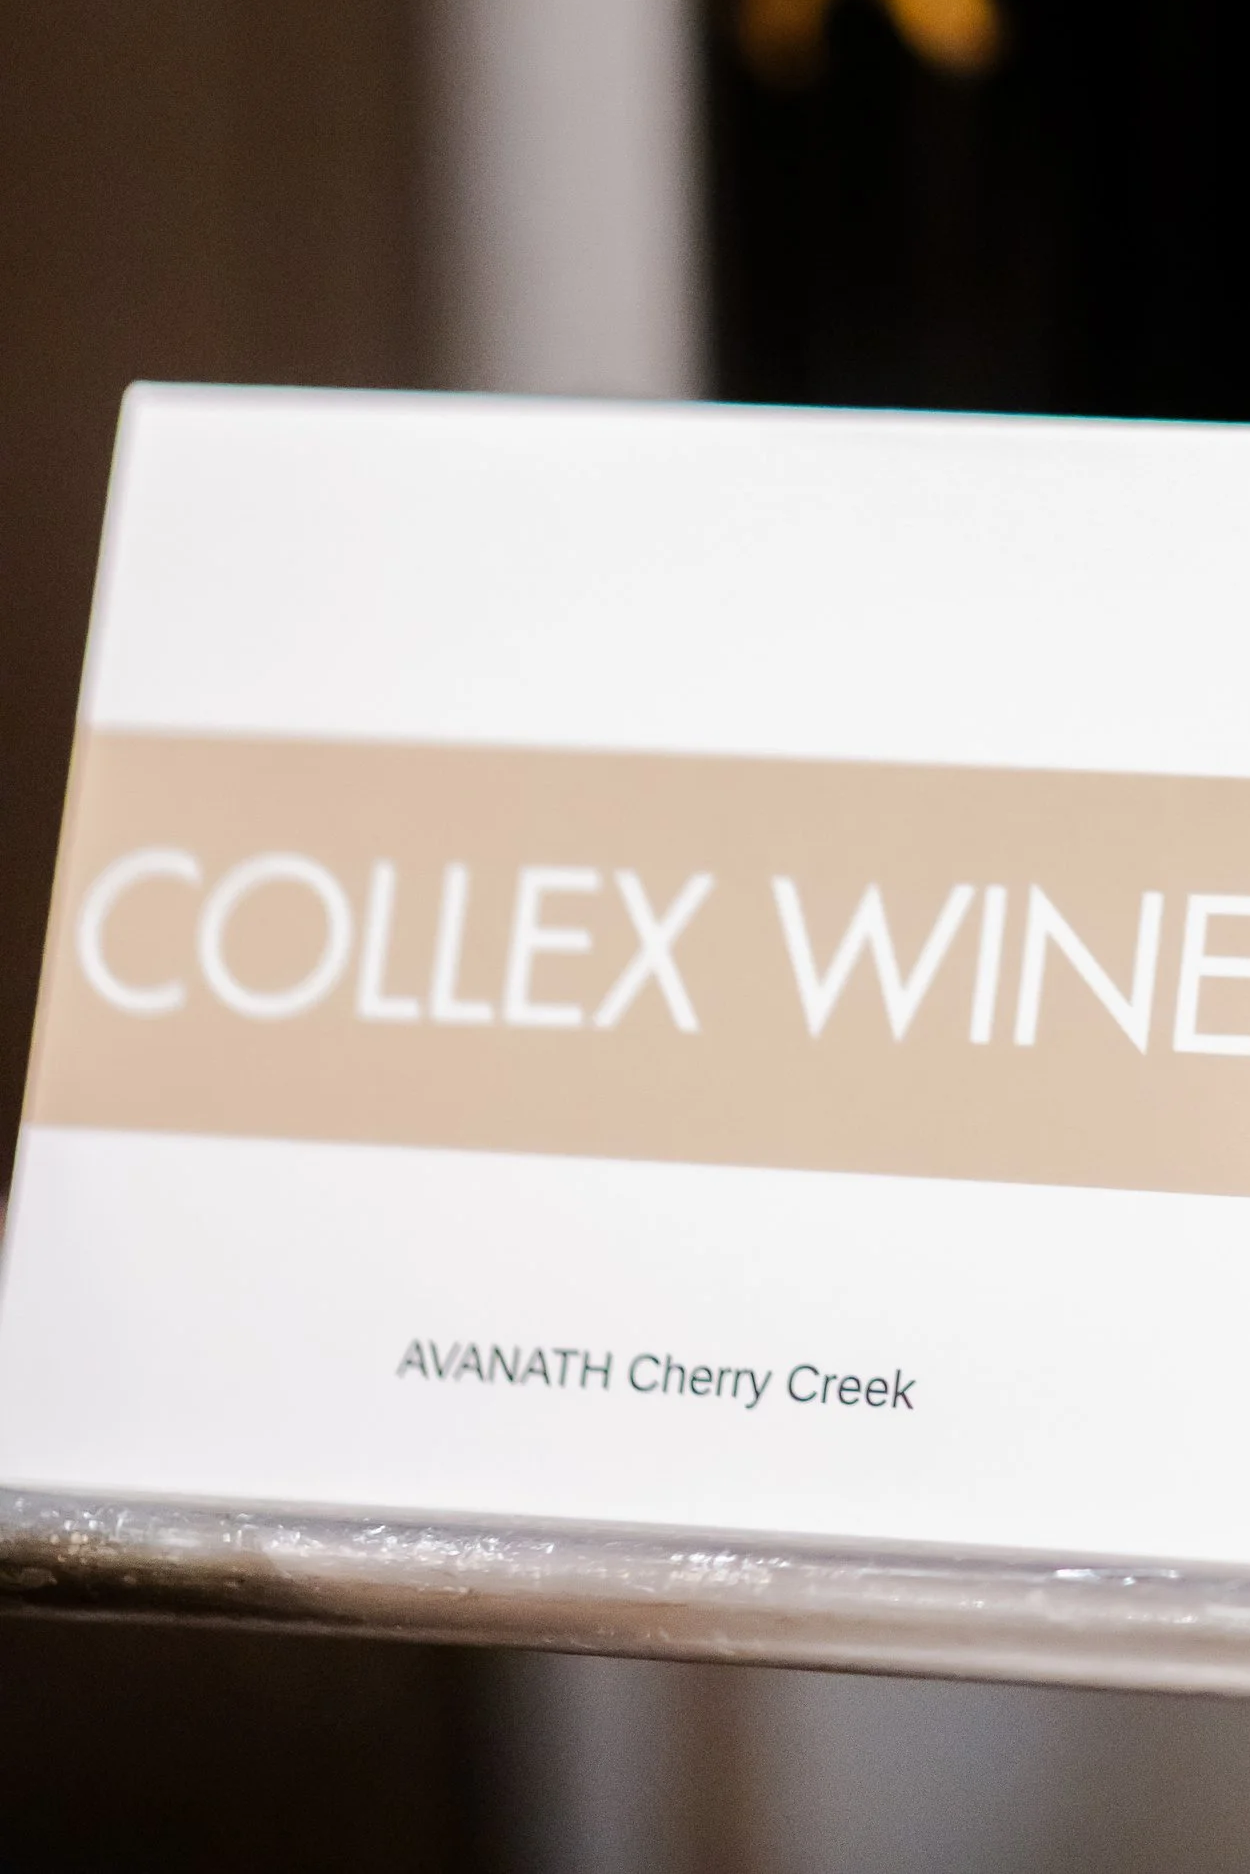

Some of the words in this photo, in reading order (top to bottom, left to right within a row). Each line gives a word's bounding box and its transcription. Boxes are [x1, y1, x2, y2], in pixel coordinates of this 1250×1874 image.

[76, 848, 713, 1032] COLLEX
[396, 1339, 613, 1390] AVANATH
[628, 1354, 773, 1410] Cherry
[787, 1364, 917, 1410] Creek
